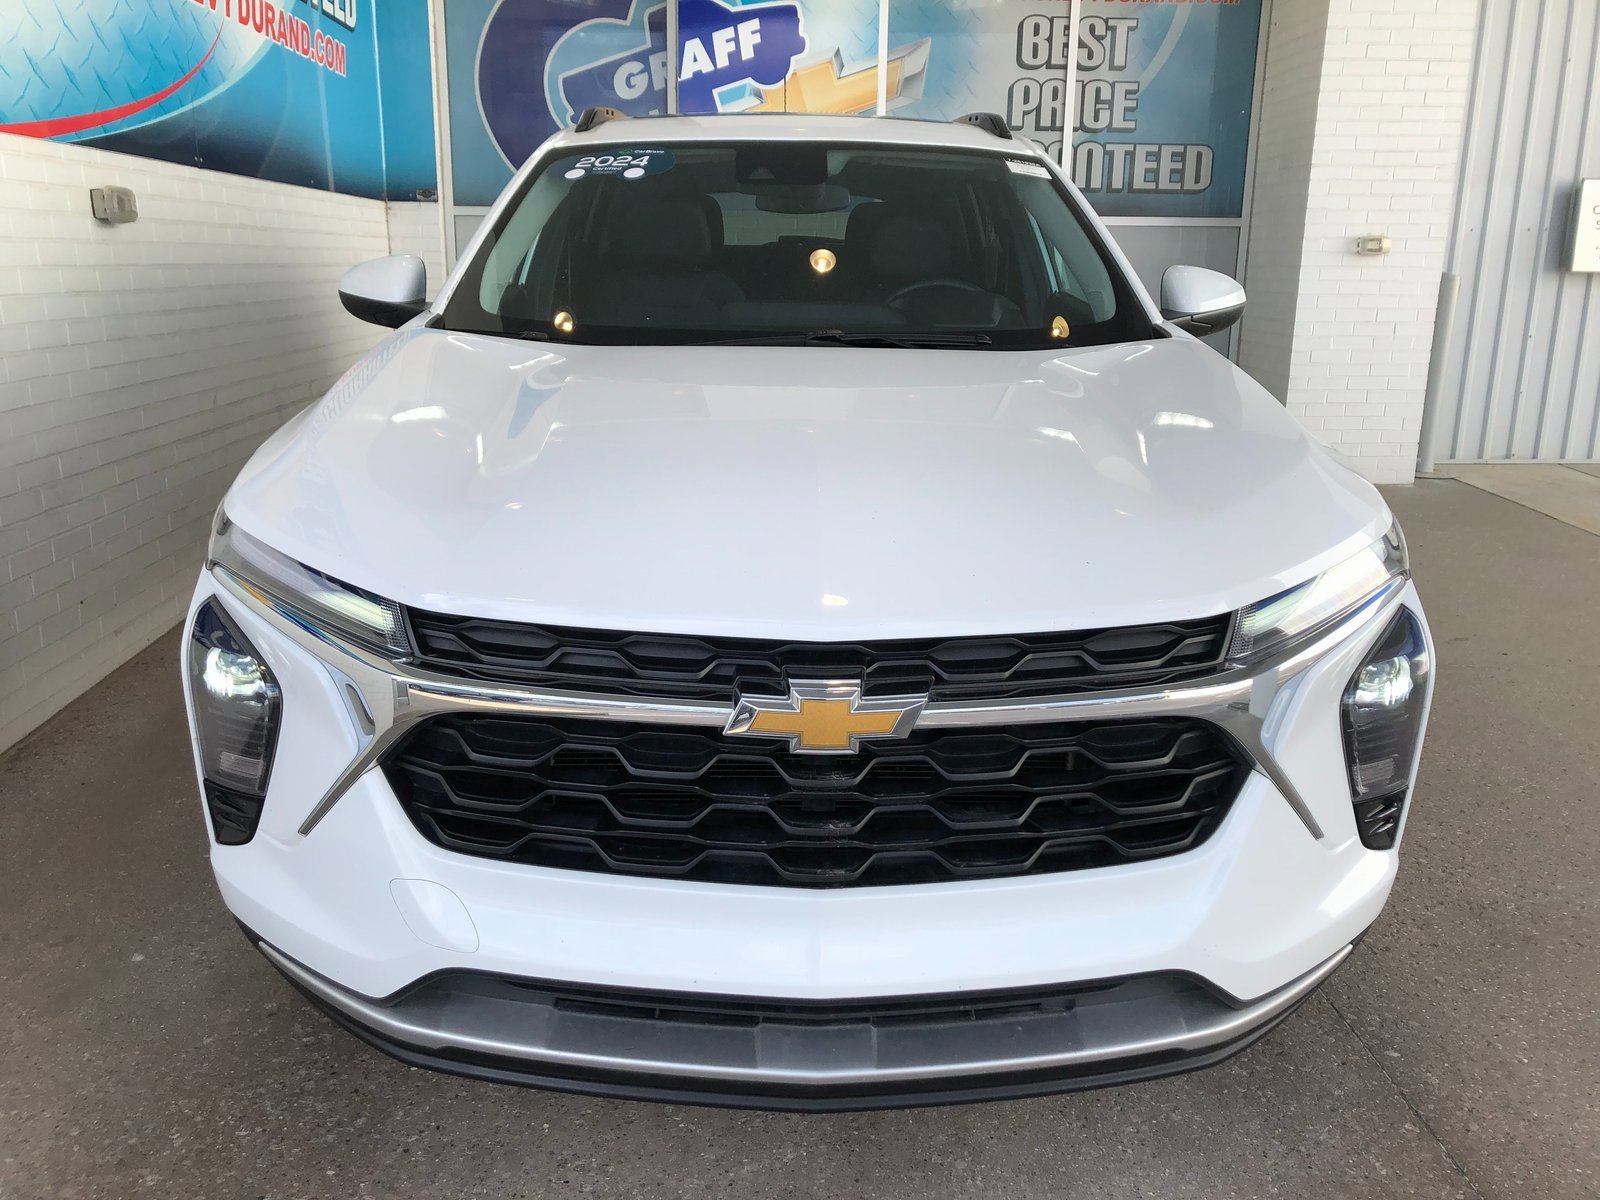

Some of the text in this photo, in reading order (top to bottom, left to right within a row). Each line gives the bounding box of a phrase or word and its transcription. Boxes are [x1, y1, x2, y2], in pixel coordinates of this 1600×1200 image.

[190, 0, 346, 76] DURAND.COM
[1017, 15, 1138, 70] BEST
[1008, 77, 1139, 133] PRICE
[575, 155, 650, 168] 2024
[1033, 141, 1214, 194] NTEED
